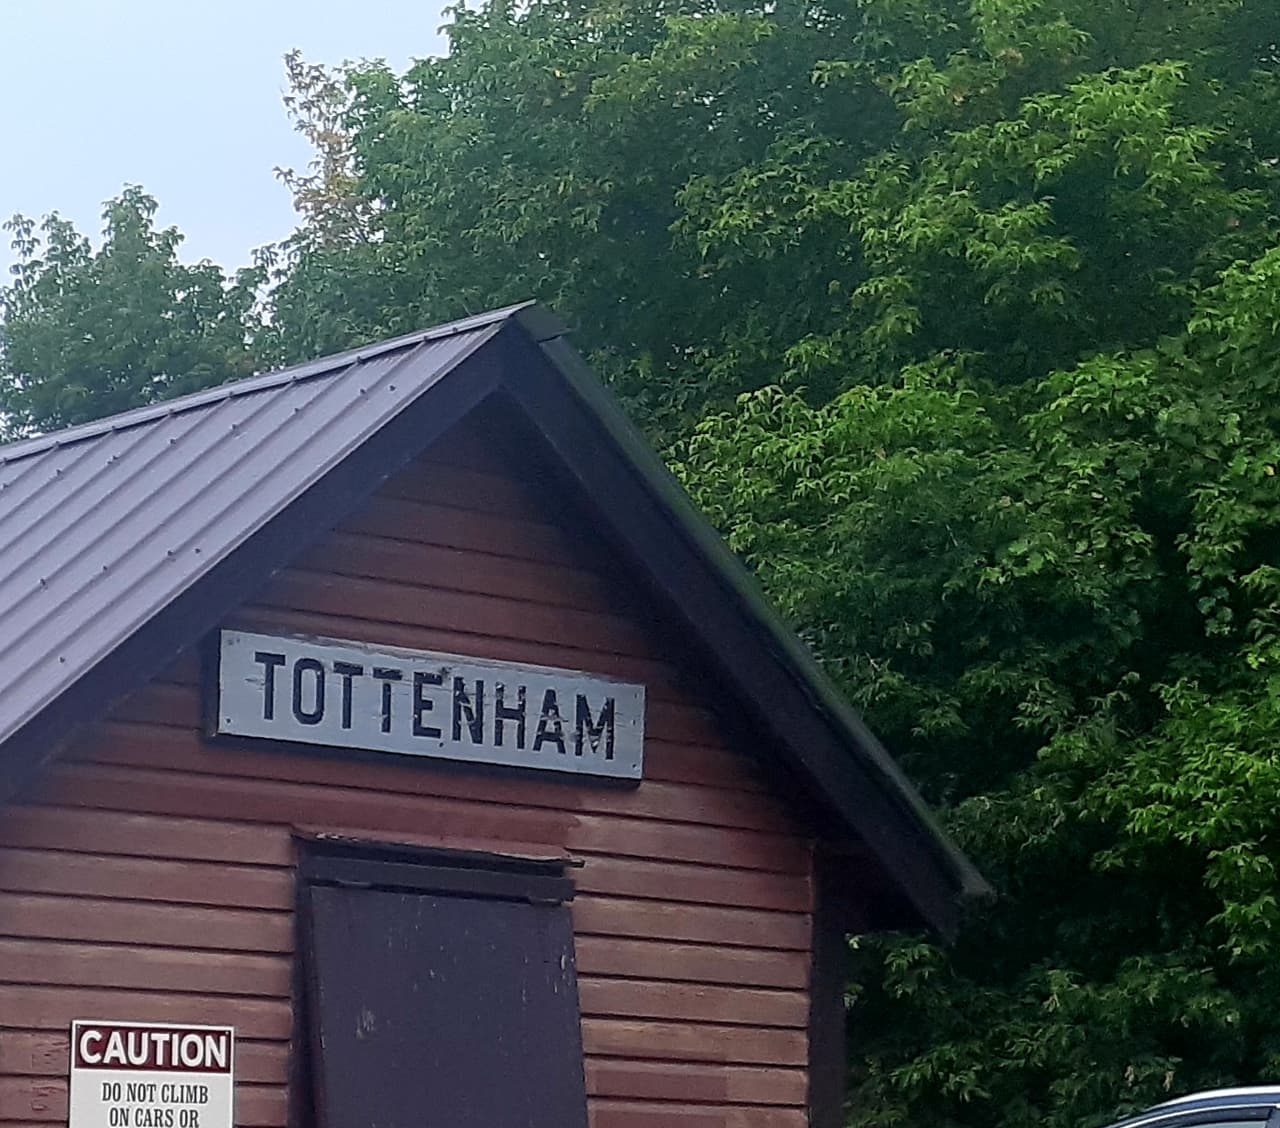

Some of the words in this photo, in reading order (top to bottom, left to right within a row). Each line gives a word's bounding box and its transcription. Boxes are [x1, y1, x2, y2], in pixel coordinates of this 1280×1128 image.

[254, 651, 616, 760] TOTTENHAM
[80, 1030, 226, 1068] CAUTION
[102, 1082, 121, 1102] DO
[126, 1083, 156, 1103] NOT
[161, 1084, 208, 1104] CLIMB
[109, 1107, 130, 1127] ON
[135, 1108, 174, 1128] CARS
[179, 1109, 199, 1128] OR
